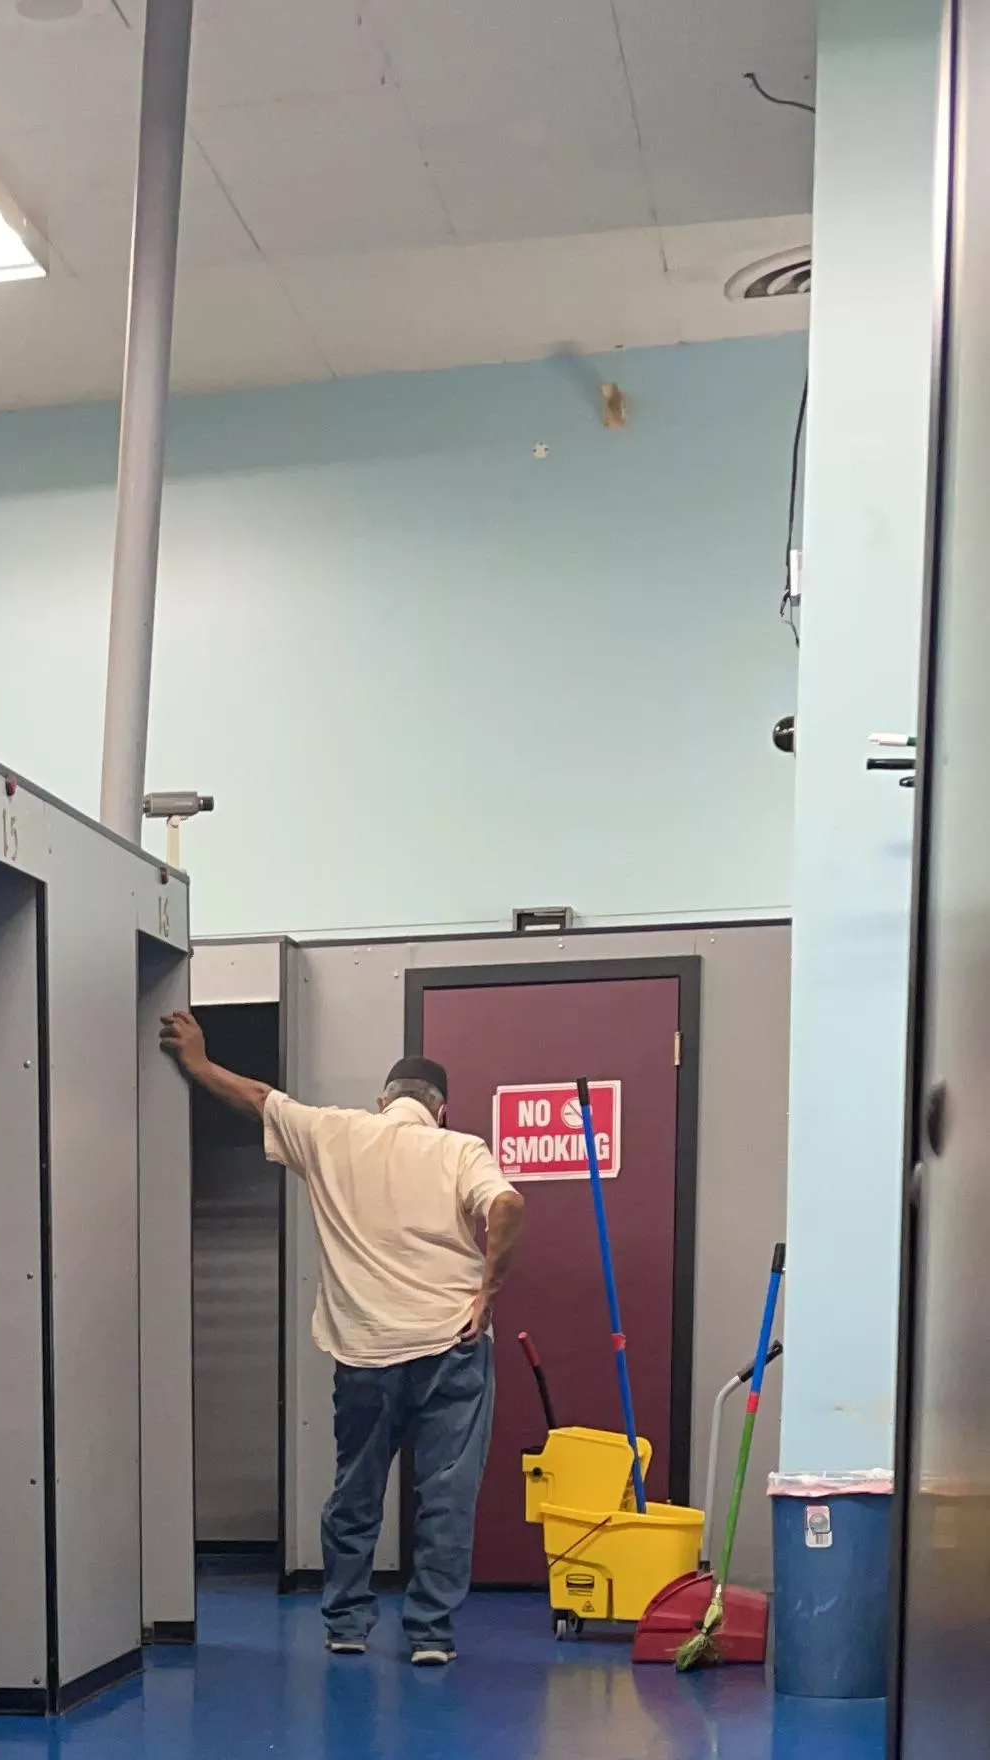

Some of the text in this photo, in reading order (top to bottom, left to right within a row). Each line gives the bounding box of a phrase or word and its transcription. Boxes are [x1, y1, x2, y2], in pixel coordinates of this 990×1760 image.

[2, 807, 18, 861] 15
[158, 895, 170, 938] 16
[518, 1099, 551, 1128] NO
